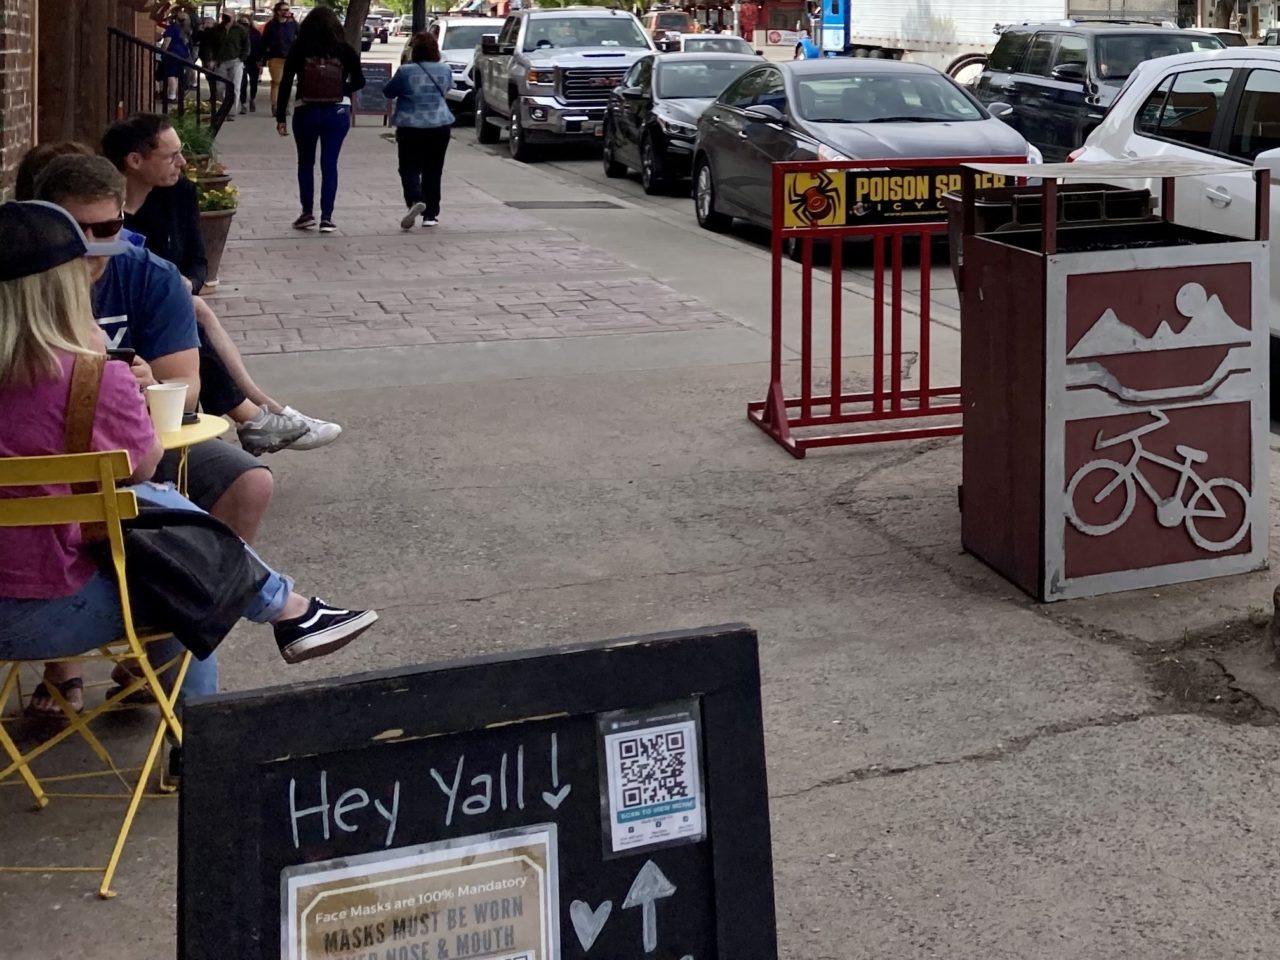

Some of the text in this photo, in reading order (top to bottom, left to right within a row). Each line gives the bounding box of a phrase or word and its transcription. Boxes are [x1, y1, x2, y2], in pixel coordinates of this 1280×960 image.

[856, 176, 929, 201] POISON
[289, 744, 524, 848] Hey Yall
[315, 876, 528, 924] Face Masks are 100% Mandatory
[324, 895, 524, 954] MASKS MUST BE WORN
[437, 939, 449, 958] &
[456, 925, 515, 957] MOUTH
